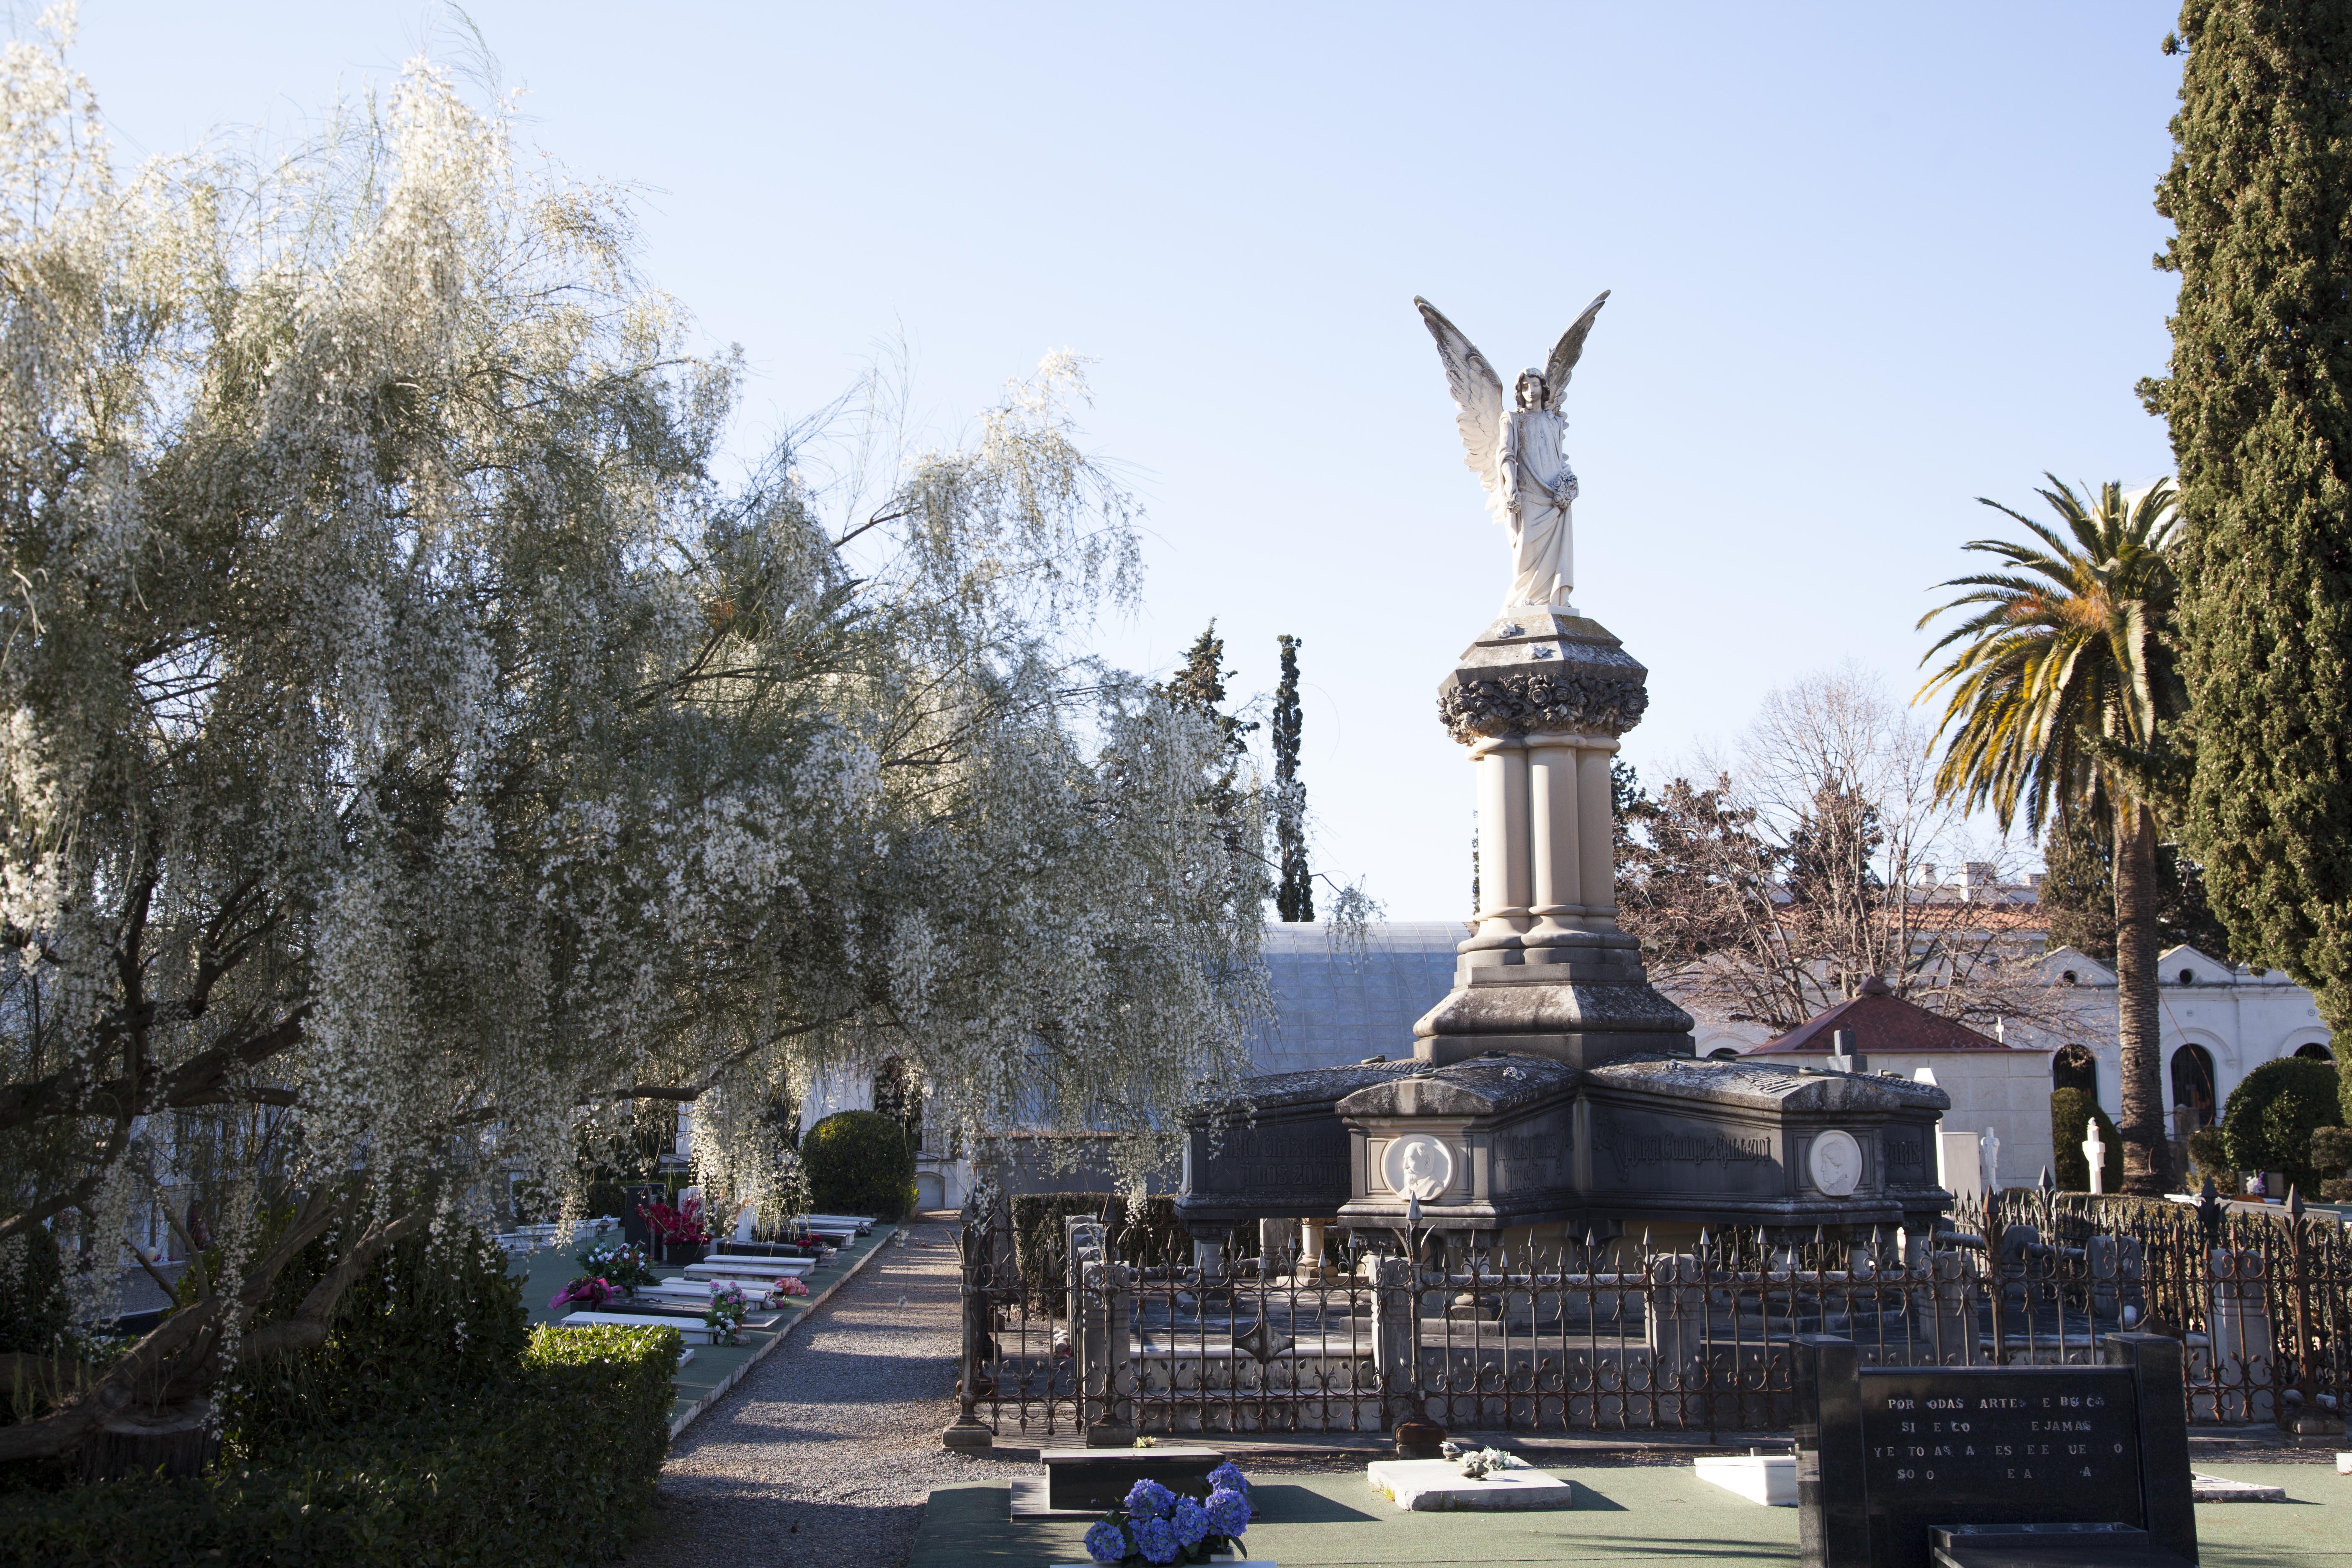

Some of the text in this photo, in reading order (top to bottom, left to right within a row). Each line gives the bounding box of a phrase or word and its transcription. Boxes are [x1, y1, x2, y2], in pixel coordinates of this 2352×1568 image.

[1292, 1164, 1313, 1185] 20
[1888, 1399, 1915, 1409] POR
[2044, 1421, 2091, 1431] JAMAS
